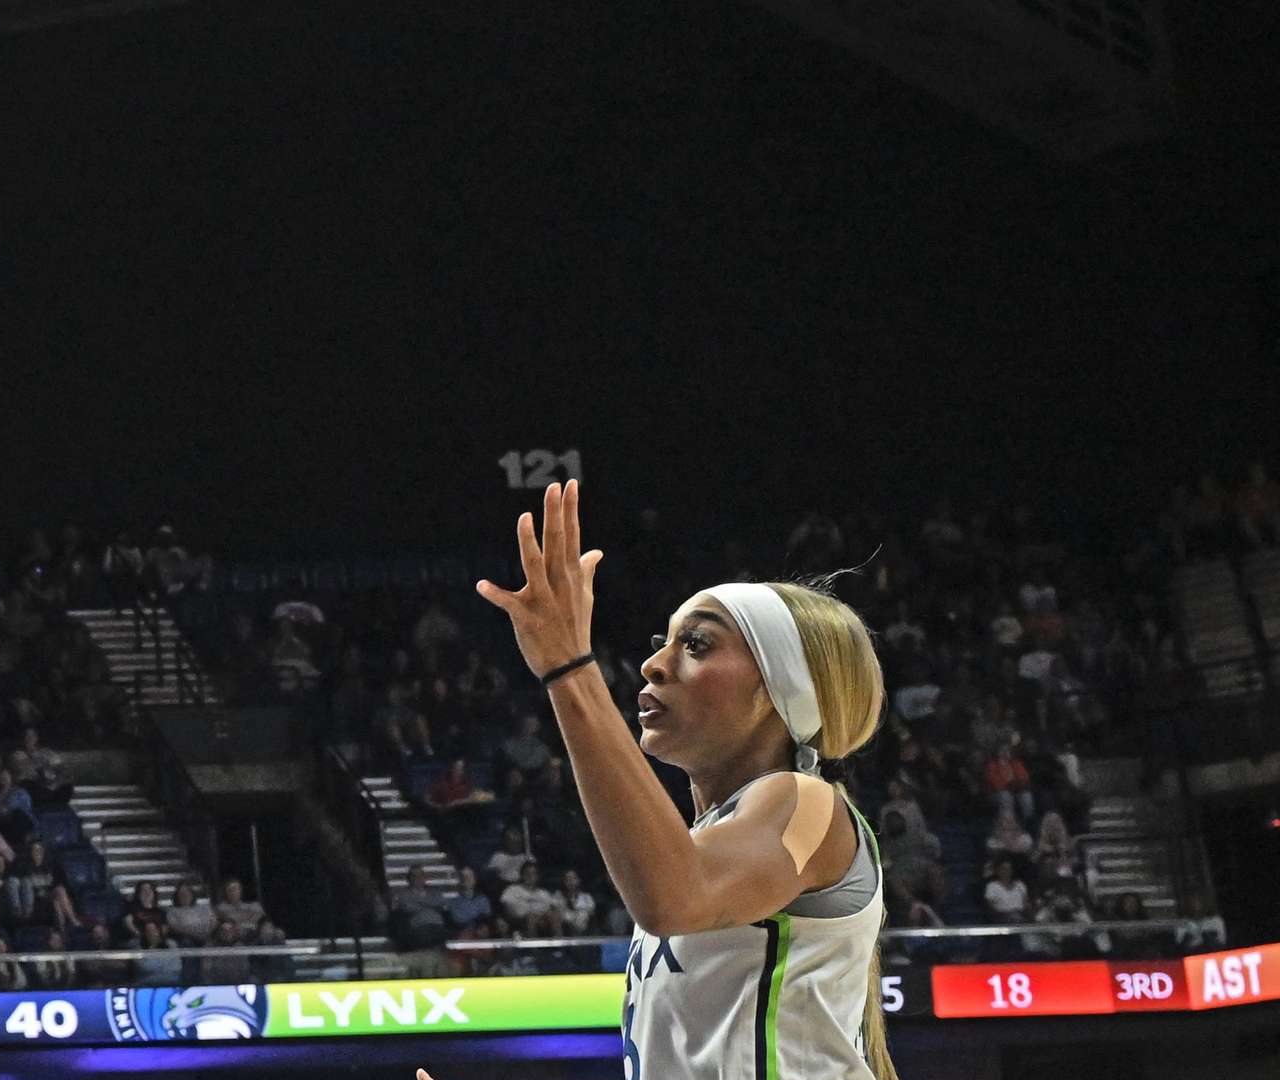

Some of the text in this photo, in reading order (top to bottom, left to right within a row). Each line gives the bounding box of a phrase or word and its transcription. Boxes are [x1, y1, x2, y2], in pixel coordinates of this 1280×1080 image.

[499, 450, 582, 488] 121
[987, 952, 1263, 1009] 18 3RD AST
[6, 999, 79, 1039] 40
[287, 987, 470, 1029] LYNX
